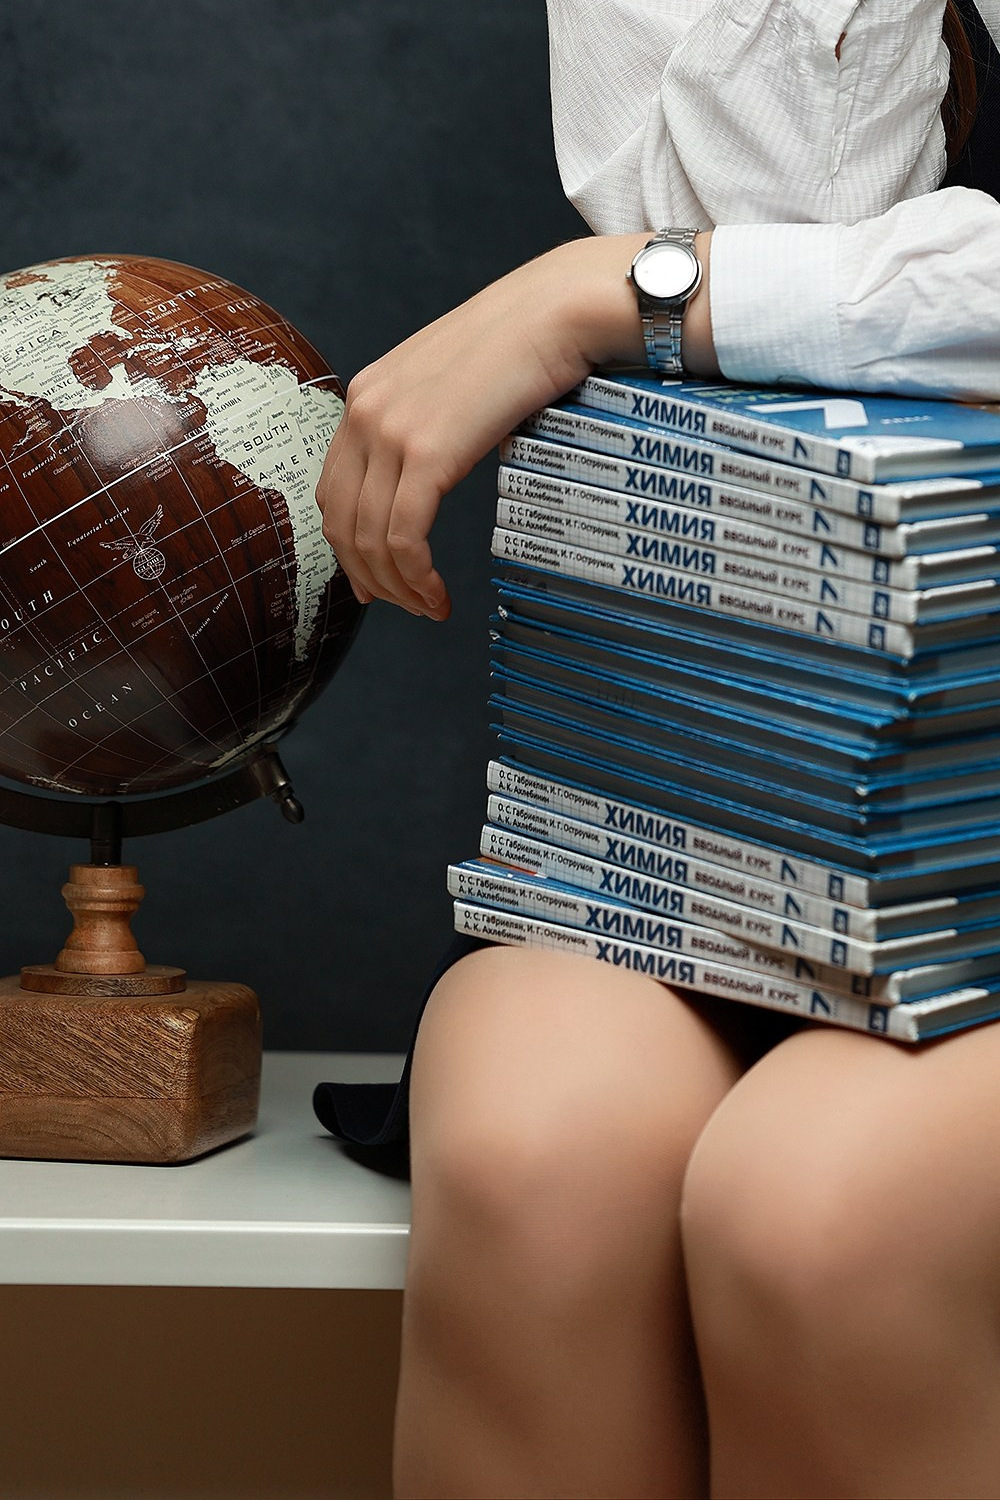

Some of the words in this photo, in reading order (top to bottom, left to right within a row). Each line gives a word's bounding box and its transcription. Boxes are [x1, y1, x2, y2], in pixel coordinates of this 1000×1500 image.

[210, 365, 244, 383] VENEZUELA
[208, 397, 242, 418] COLOMBIA
[632, 392, 707, 434] ХИМИЯ
[713, 420, 758, 440] ВВОДНЫЙ
[243, 421, 290, 452] SOUTH
[302, 425, 335, 446] BRAZIL
[631, 434, 714, 475] ХИМИЯ
[721, 462, 771, 481] ВВОДНЫЙ
[22, 453, 57, 479] Equatorial
[237, 456, 256, 471] PERU
[258, 438, 331, 483] AMERIC
[625, 467, 712, 507] ХИМИЯ
[719, 494, 772, 513] ВВОДНЫЙ
[625, 501, 716, 541] ХИМИЯ
[723, 529, 778, 548] ВВОДНЫЙ
[29, 558, 48, 573] South
[626, 533, 716, 574] ХИМИЯ
[724, 562, 778, 581] ВВОДНЫЙ
[212, 592, 229, 614] Current
[302, 573, 312, 630] ARGENTINA
[622, 564, 711, 606] ХИМИЯ
[719, 593, 774, 614] ВВОДНЫЙ
[19, 631, 102, 691] PACIFIC
[68, 682, 133, 728] OCEAN
[605, 803, 686, 849] ХИМИЯ
[693, 837, 742, 859] ВВОДНЫЙ
[605, 836, 688, 883] ХИМИЯ
[695, 870, 745, 893] ВВОДНЫЙ
[599, 867, 685, 914] ХИМИЯ
[691, 901, 742, 924] ВВОДНЫЙ
[585, 904, 683, 948] ХИМИЯ
[691, 936, 750, 957] ВВОДНЫЙ
[595, 941, 695, 984] ХИМИЯ
[703, 972, 764, 993] ВВОДНЫЙ
